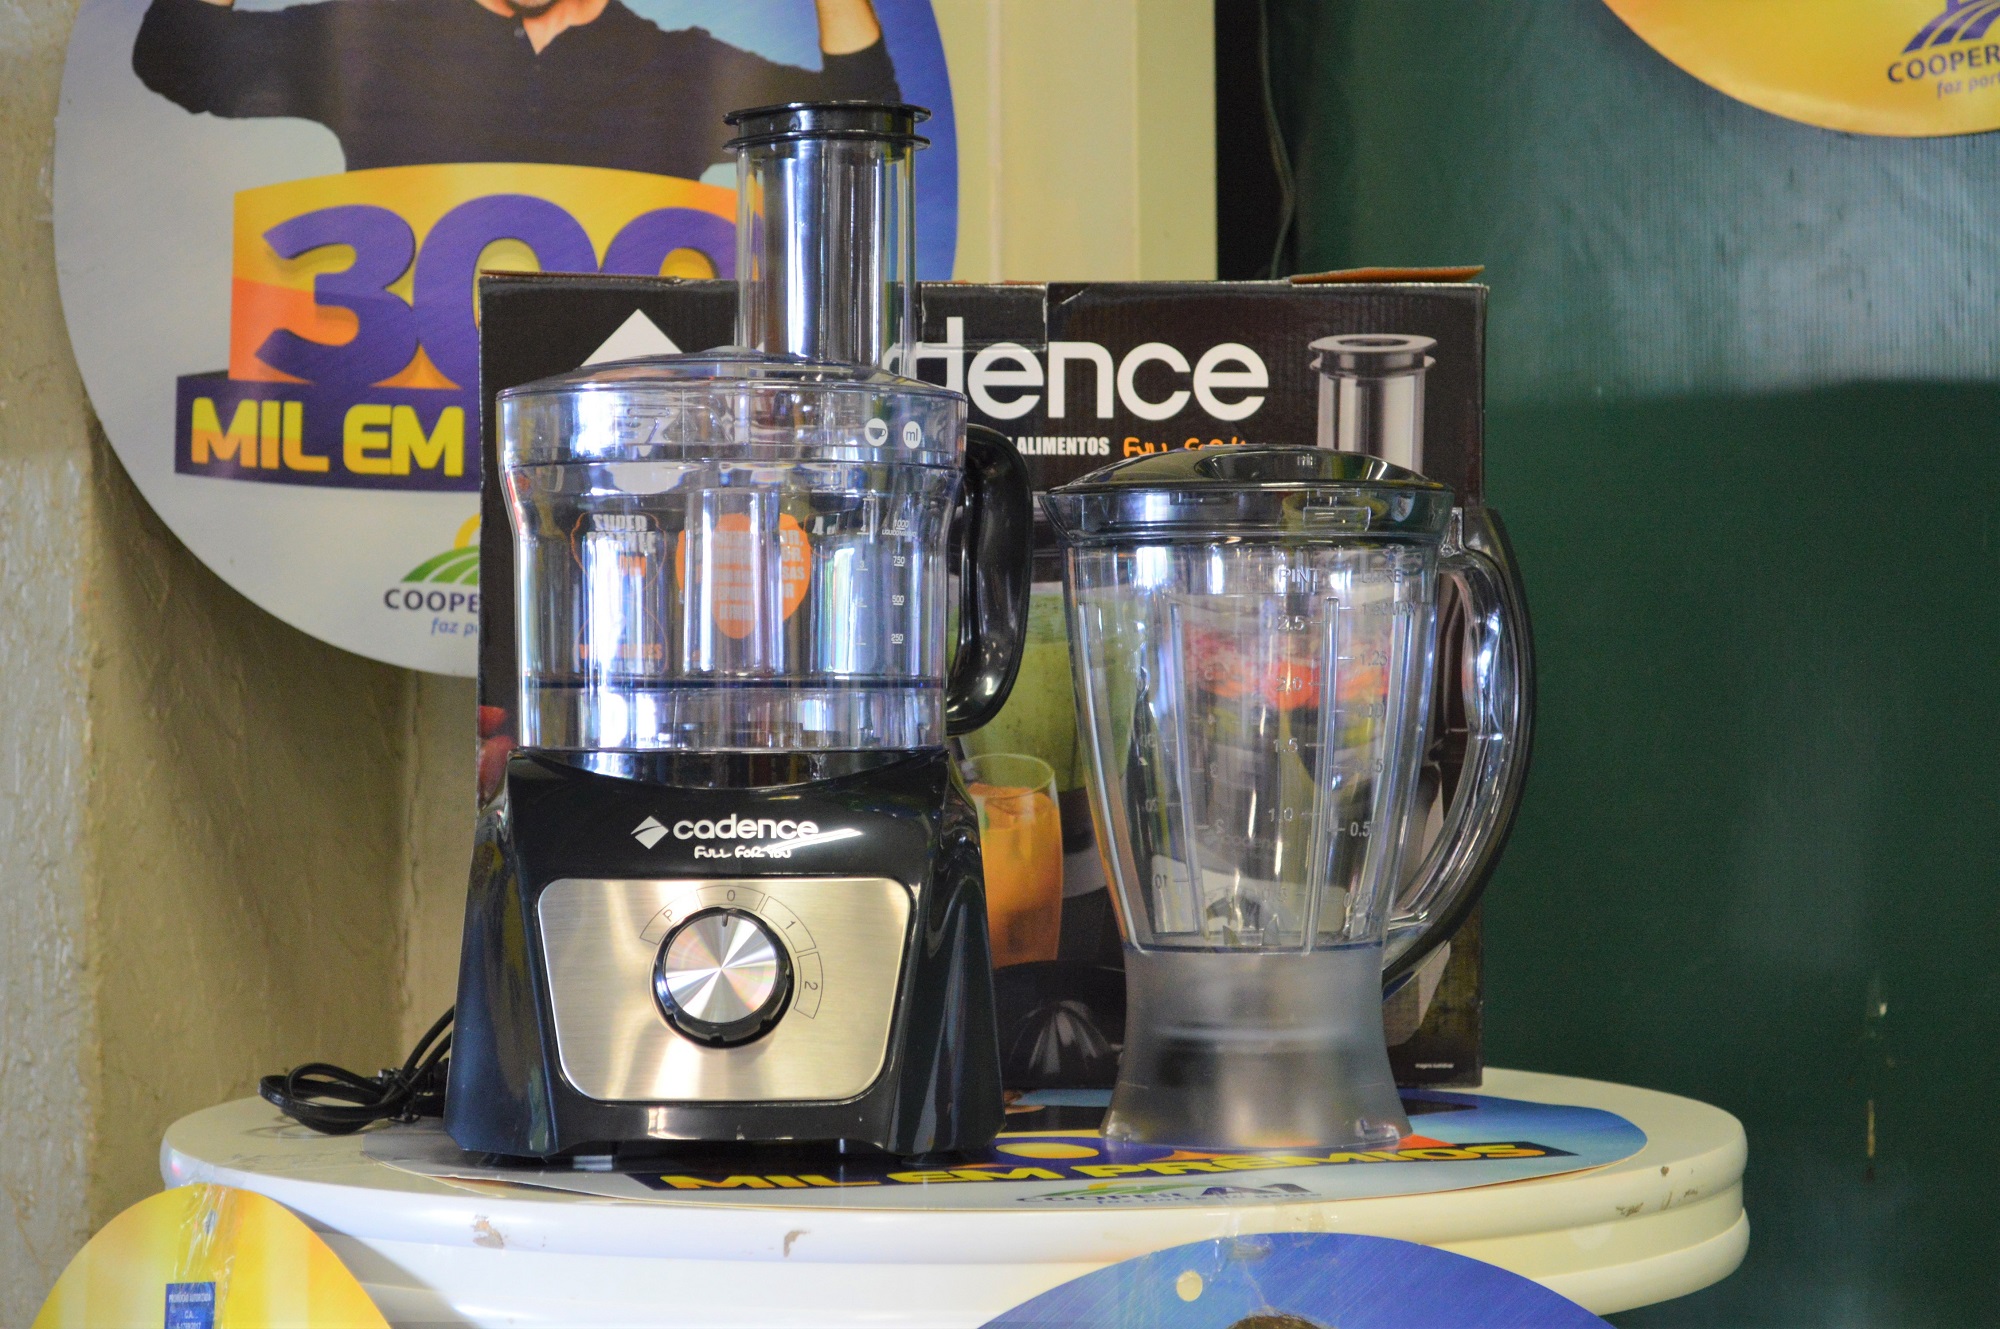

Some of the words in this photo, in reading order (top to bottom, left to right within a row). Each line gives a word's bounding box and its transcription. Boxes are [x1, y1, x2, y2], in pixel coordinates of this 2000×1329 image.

[882, 316, 1270, 421] dence
[190, 396, 330, 473] MIL
[342, 403, 465, 477] EM
[905, 428, 919, 442] ml
[1016, 435, 1111, 456] ALIMENTOS
[893, 556, 906, 564] 750
[383, 588, 478, 613] COOPE
[892, 595, 905, 603] 500
[431, 617, 459, 636] faz
[1277, 614, 1305, 631] 2.5
[1360, 651, 1388, 667] 1.25
[1273, 738, 1299, 753] 1.5
[672, 813, 819, 840] cadence
[694, 846, 732, 859] FULL
[734, 846, 766, 858] FOR
[726, 889, 736, 902] 0
[662, 908, 674, 923] P
[785, 920, 797, 930] 1
[804, 980, 819, 991] 2
[660, 1175, 881, 1189] MIL
[886, 1167, 1066, 1184] EM
